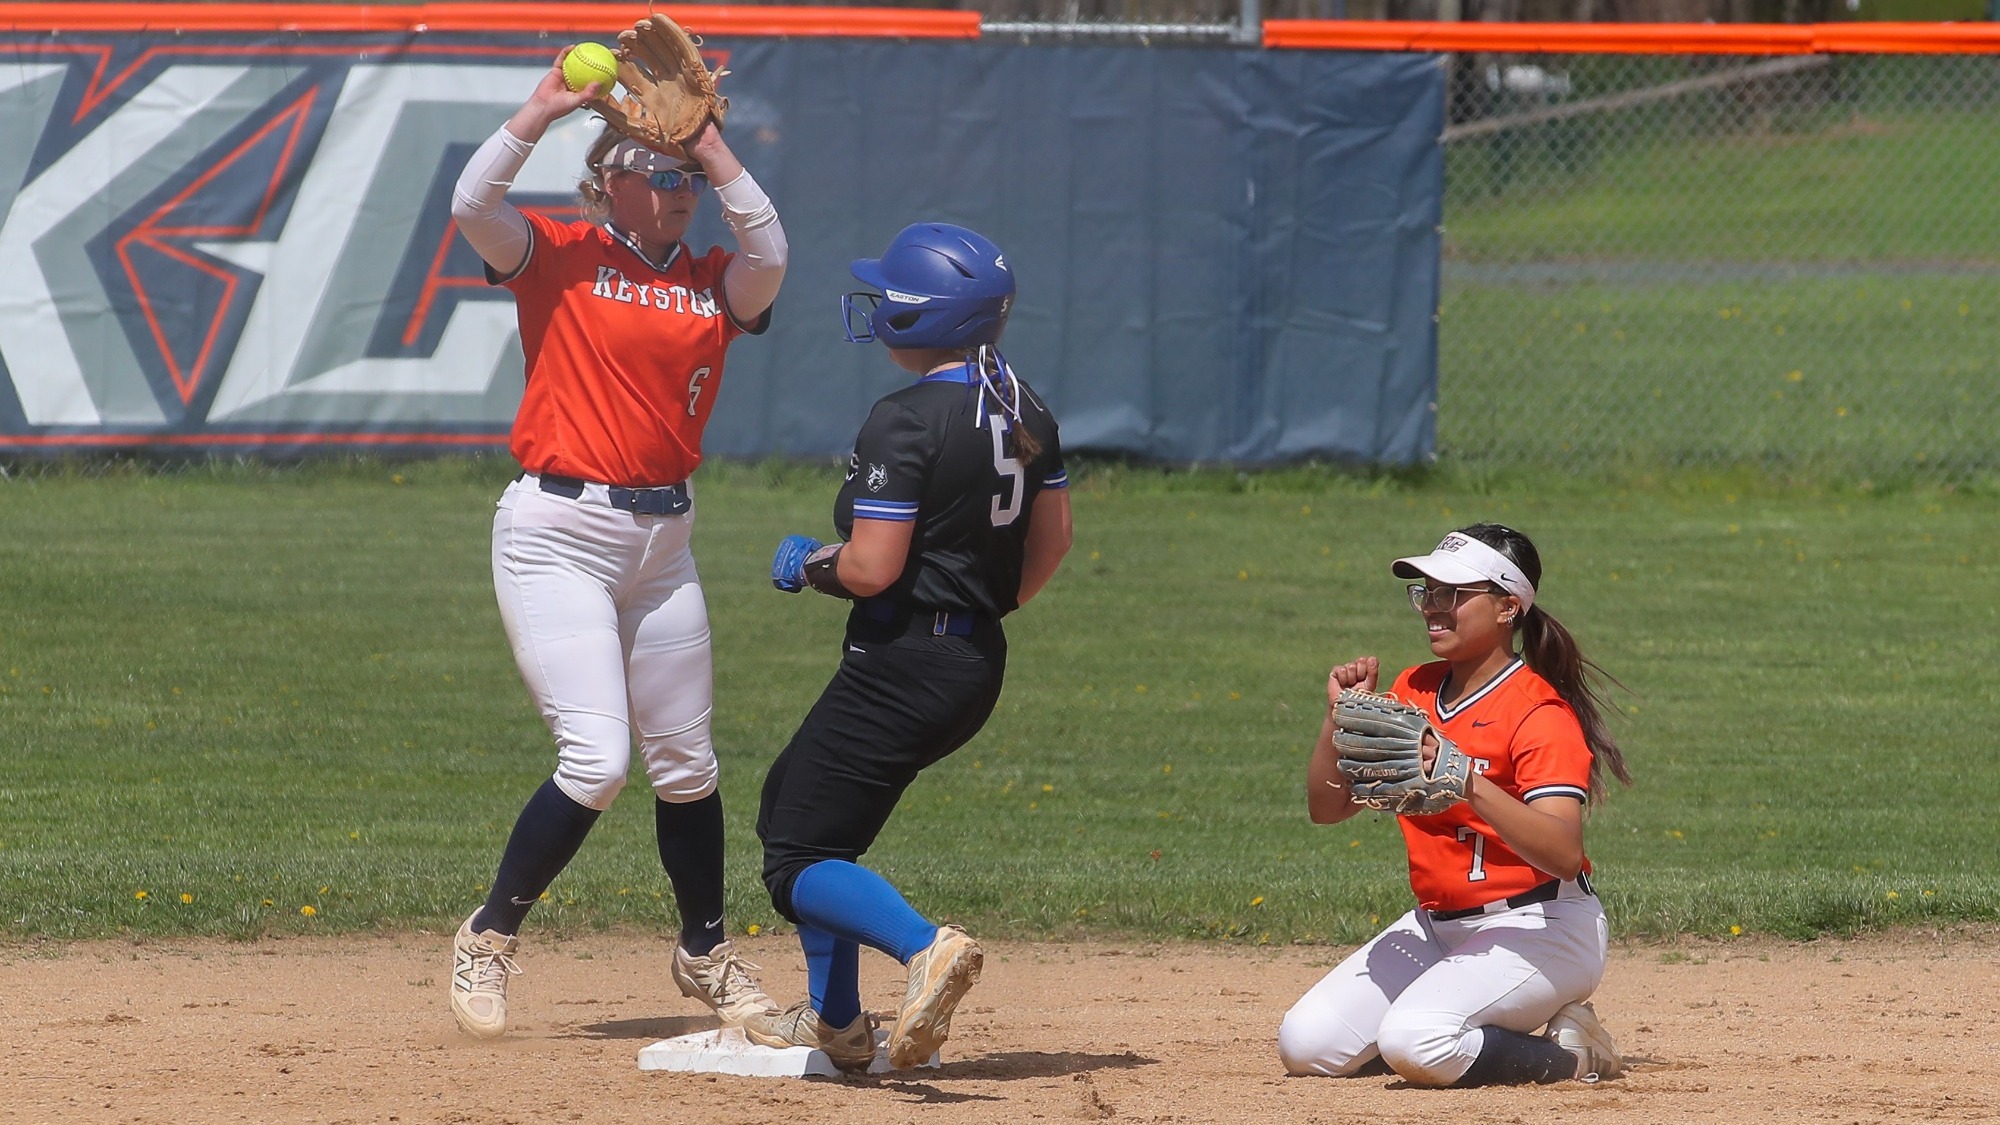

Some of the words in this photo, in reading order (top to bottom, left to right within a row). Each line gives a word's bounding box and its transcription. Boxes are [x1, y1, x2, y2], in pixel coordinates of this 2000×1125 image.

[592, 265, 722, 318] KEYSTON
[889, 292, 920, 302] EASTON
[687, 366, 711, 416] 6
[989, 414, 1025, 527] 5
[1456, 826, 1487, 883] 7
